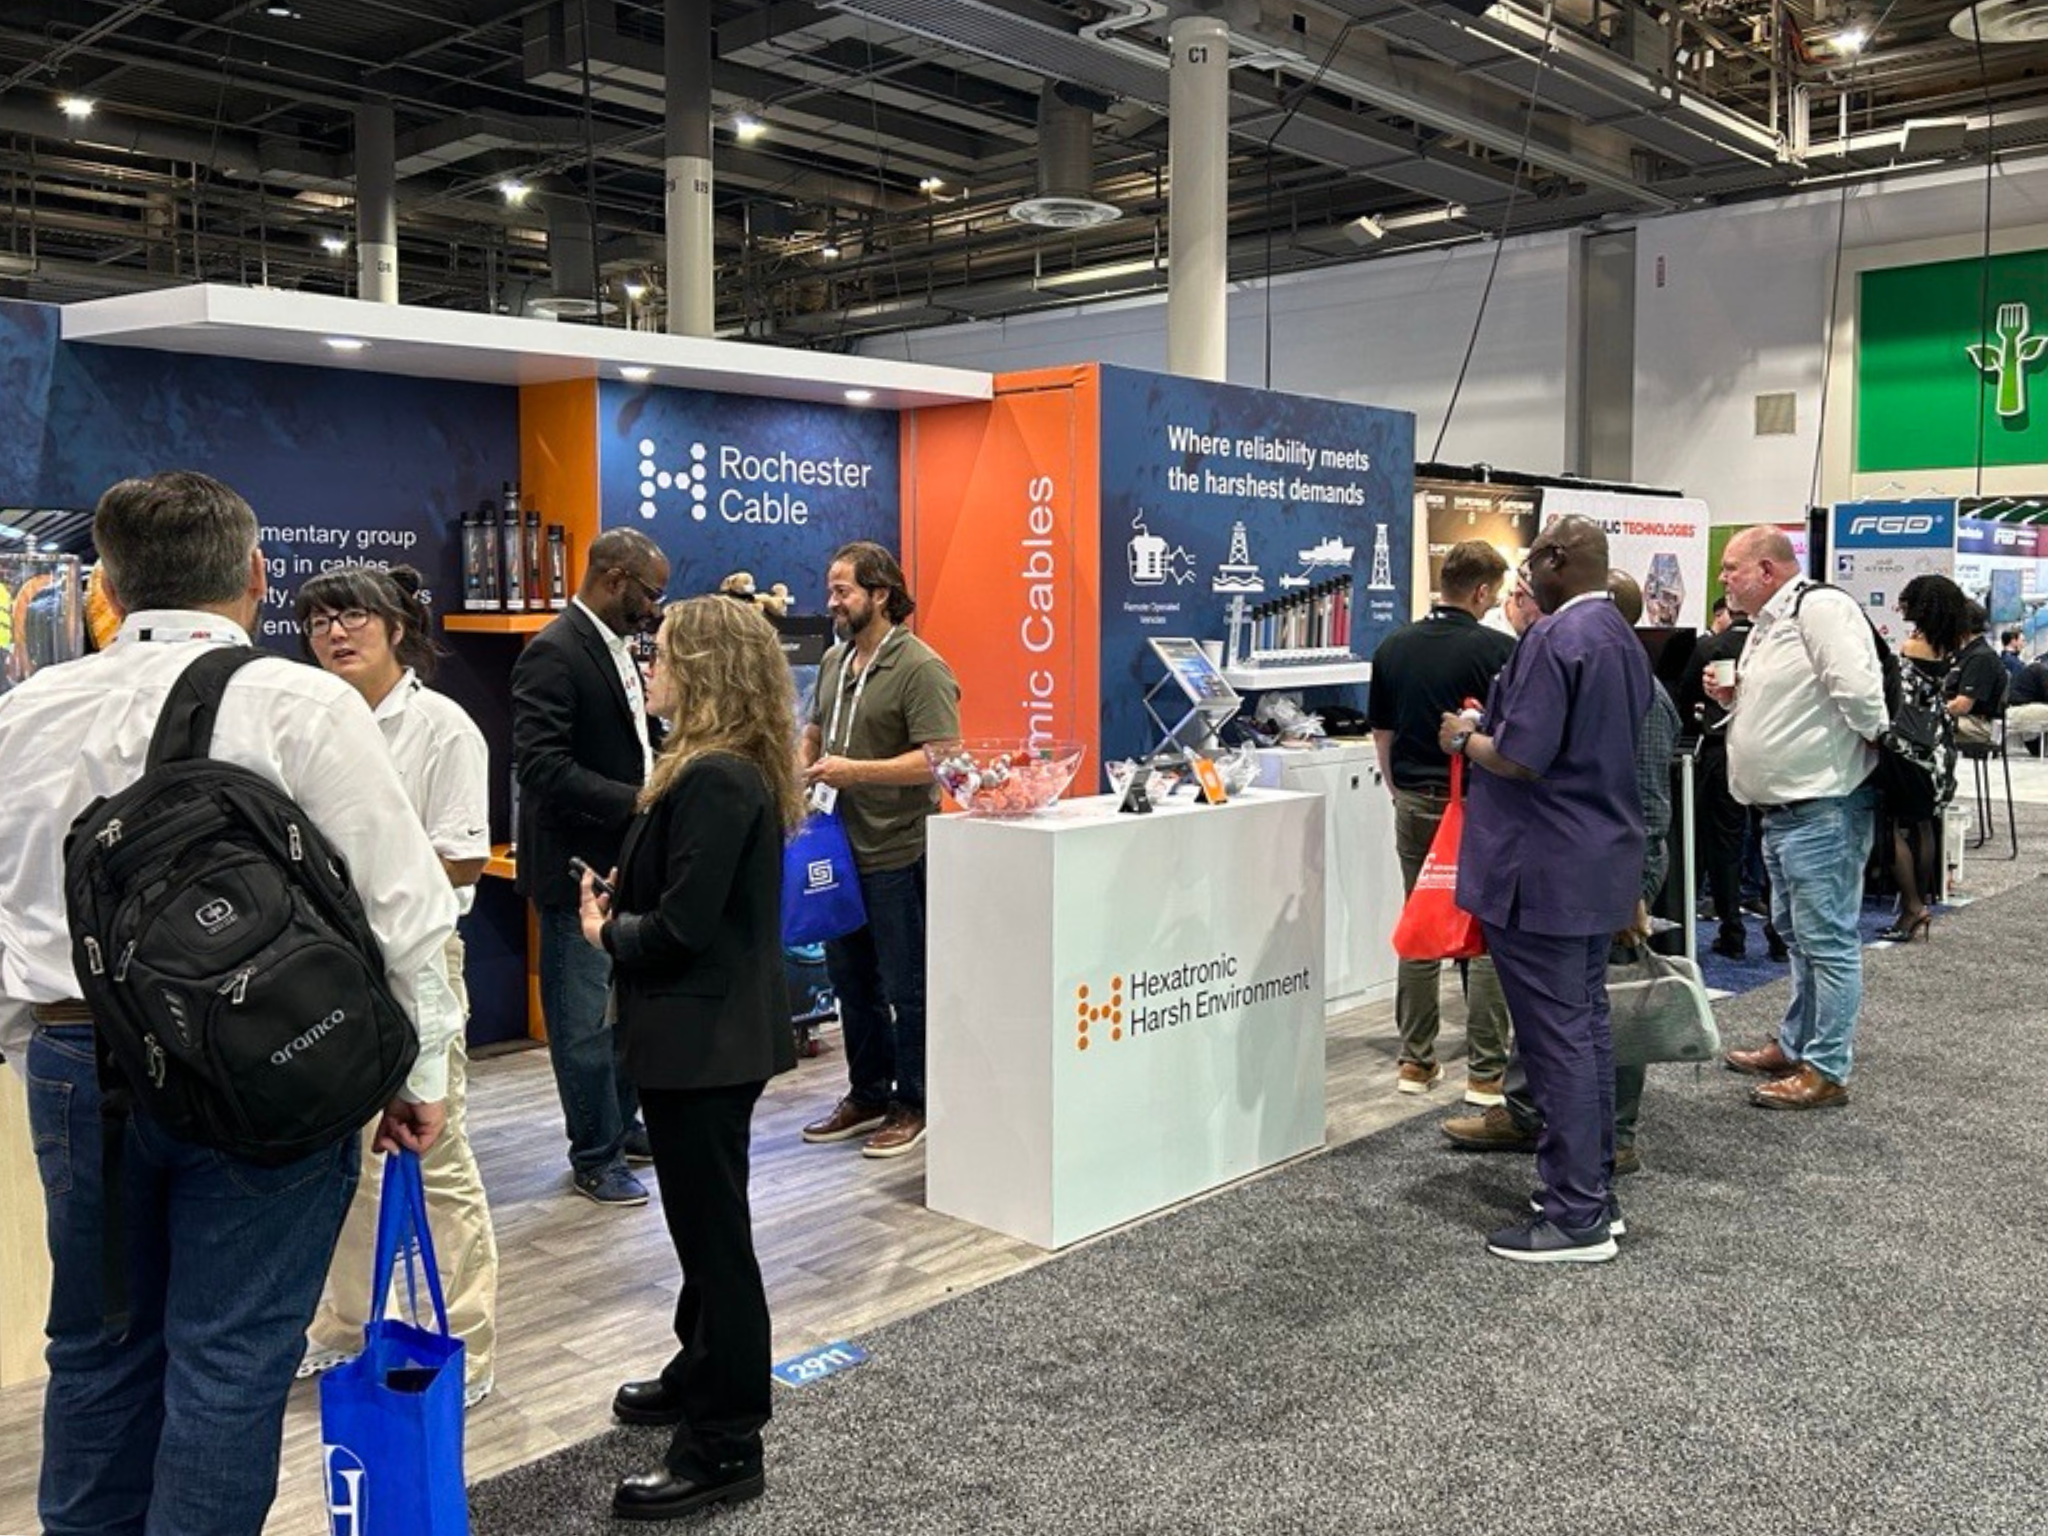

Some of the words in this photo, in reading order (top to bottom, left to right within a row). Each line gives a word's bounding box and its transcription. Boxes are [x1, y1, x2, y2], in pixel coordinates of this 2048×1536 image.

[1189, 47, 1208, 63] C1
[720, 445, 871, 487] Rochester
[1168, 425, 1231, 457] Where
[1235, 436, 1317, 471] reliability
[1321, 449, 1370, 471] meets
[1168, 466, 1199, 493] the
[1205, 469, 1285, 499] harshest
[1289, 477, 1365, 505] demands
[719, 489, 808, 525] Cable
[356, 529, 417, 549] group
[1623, 522, 1695, 537] TECHNOLOGIES
[293, 554, 313, 573] in
[1021, 476, 1054, 653] Cables
[1130, 953, 1237, 1000] Hexatronic
[1130, 997, 1190, 1036] Harsh
[1196, 967, 1310, 1019] Environment
[270, 1008, 345, 1066] aramco
